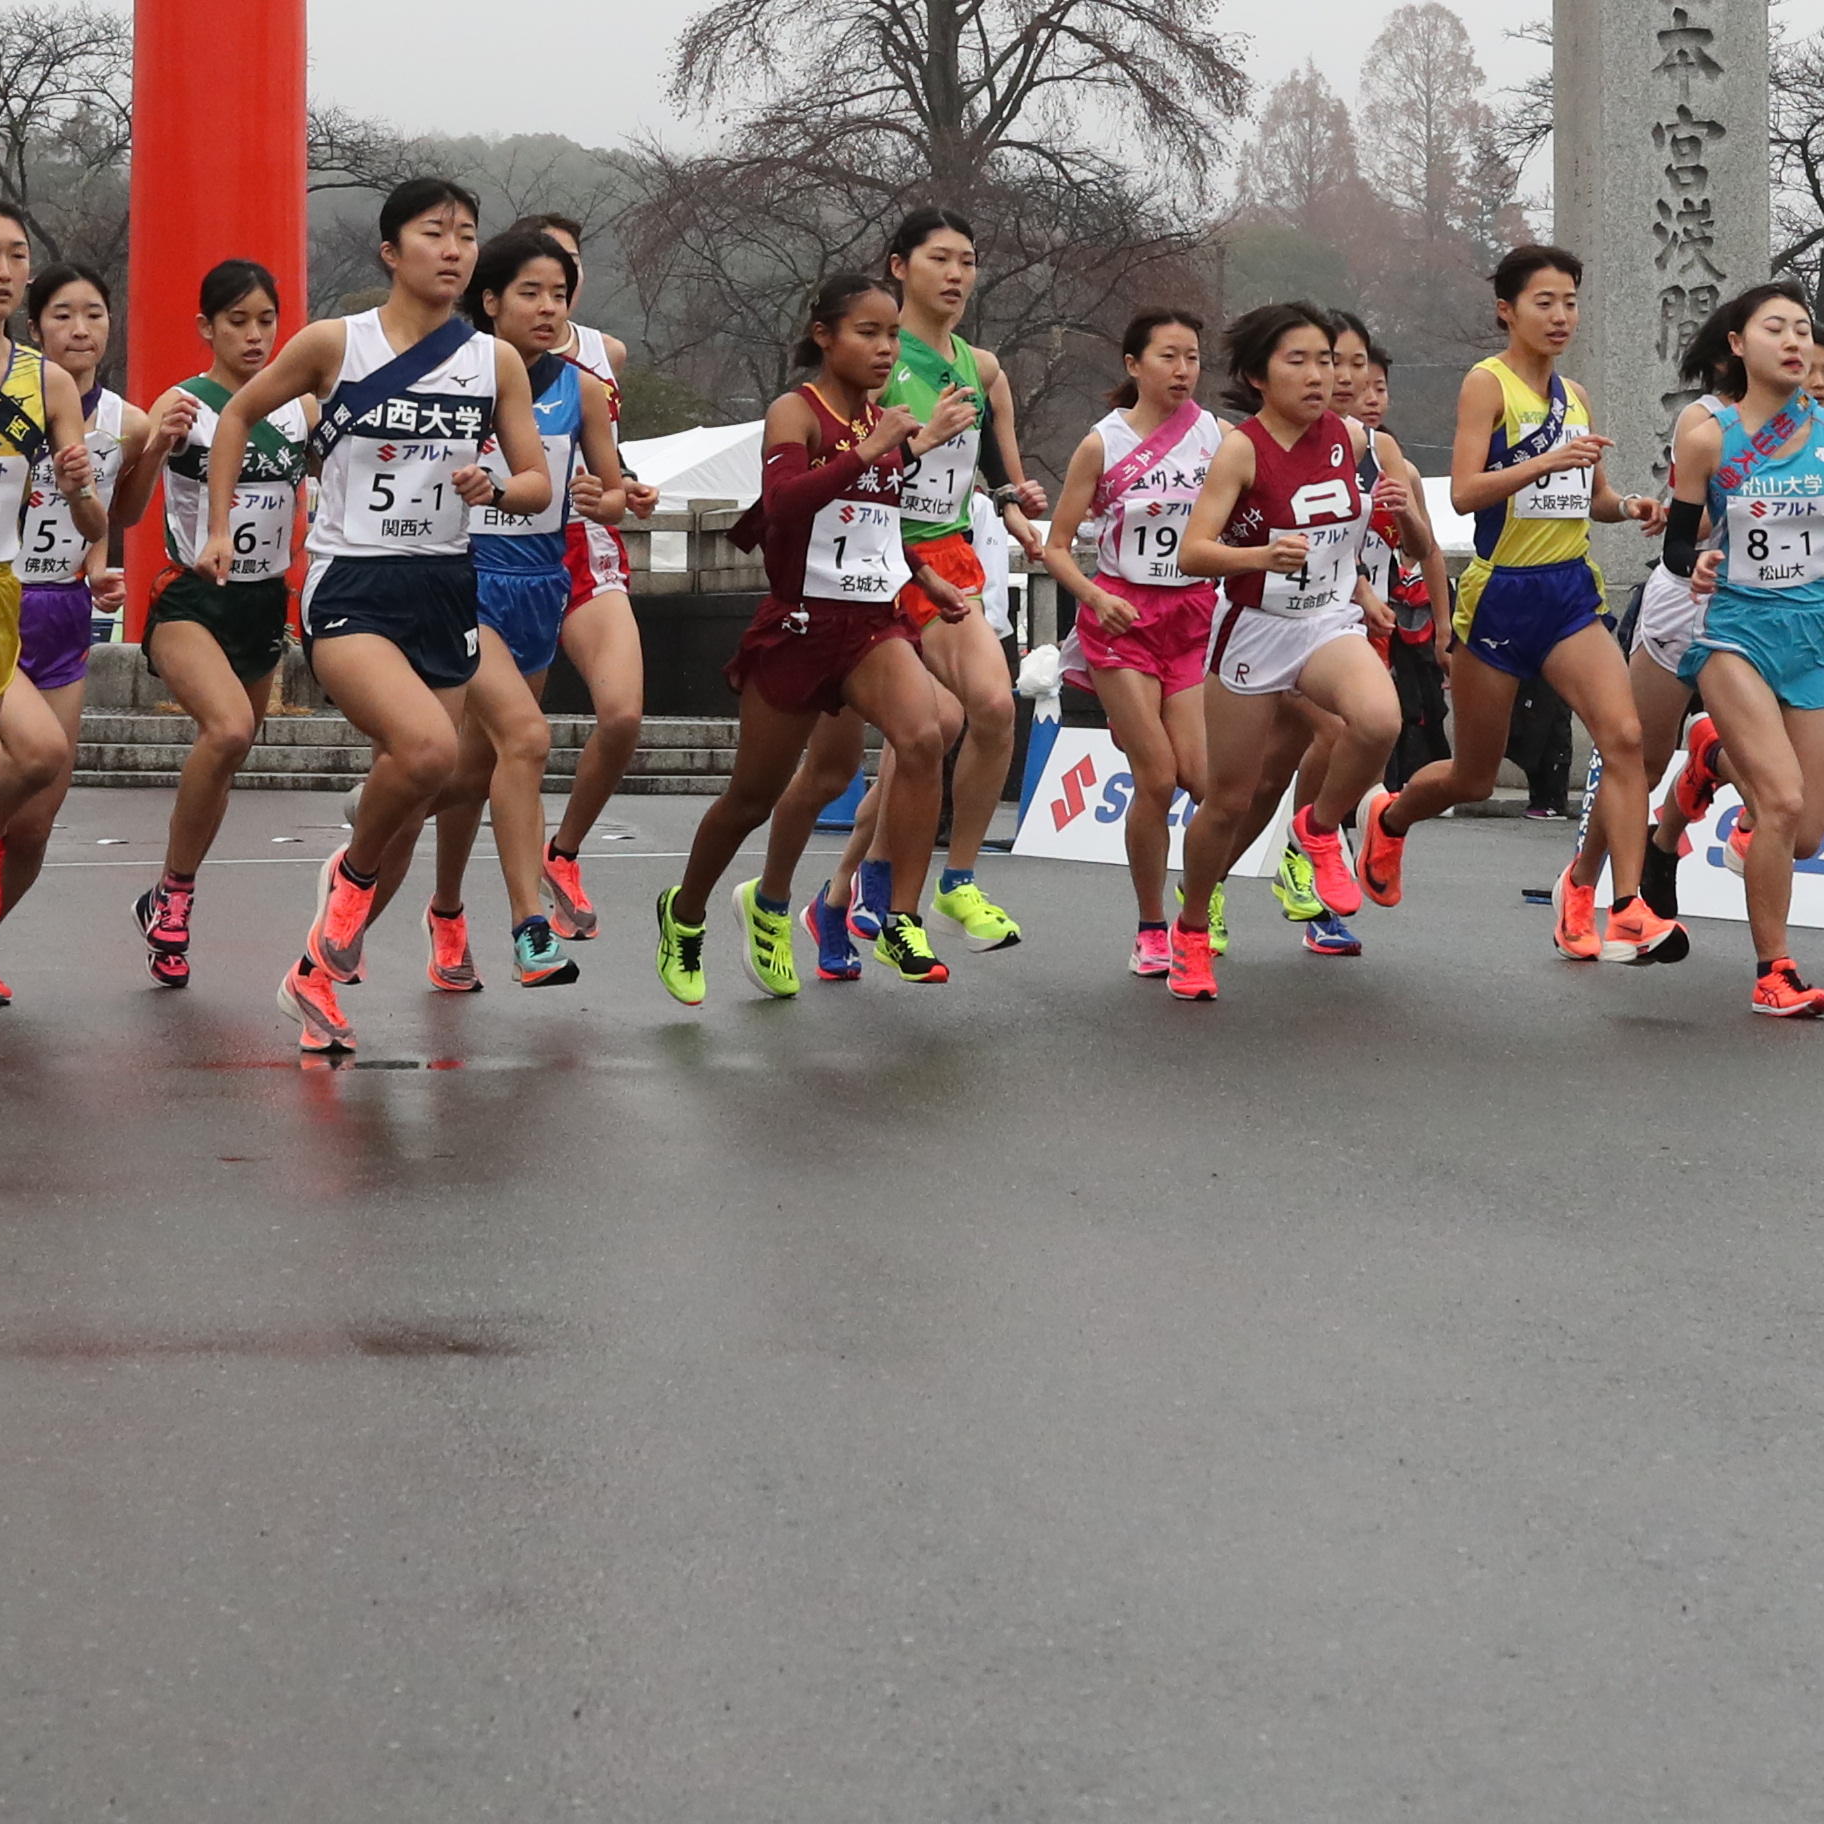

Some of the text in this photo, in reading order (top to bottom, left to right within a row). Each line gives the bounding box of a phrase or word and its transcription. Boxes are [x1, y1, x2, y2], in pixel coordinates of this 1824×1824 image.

[402, 445, 453, 462] アルト
[844, 464, 904, 495] 城大
[1740, 474, 1824, 497] 松山大学
[244, 493, 286, 510] アルト
[368, 473, 443, 512] 5-1
[859, 507, 890, 527] アルト
[1166, 503, 1192, 517] アル
[1772, 502, 1818, 517] アルト
[382, 519, 433, 537] 関西大
[1217, 507, 1264, 547] 立命
[1313, 527, 1350, 547] アルト
[1747, 528, 1812, 562] 8-1
[25, 557, 71, 573] 佛教大
[229, 558, 271, 574] 東農大
[1758, 563, 1805, 581] 松山大
[840, 575, 888, 593] 名城大
[1285, 589, 1340, 611] 立命館大
[1235, 662, 1250, 685] R
